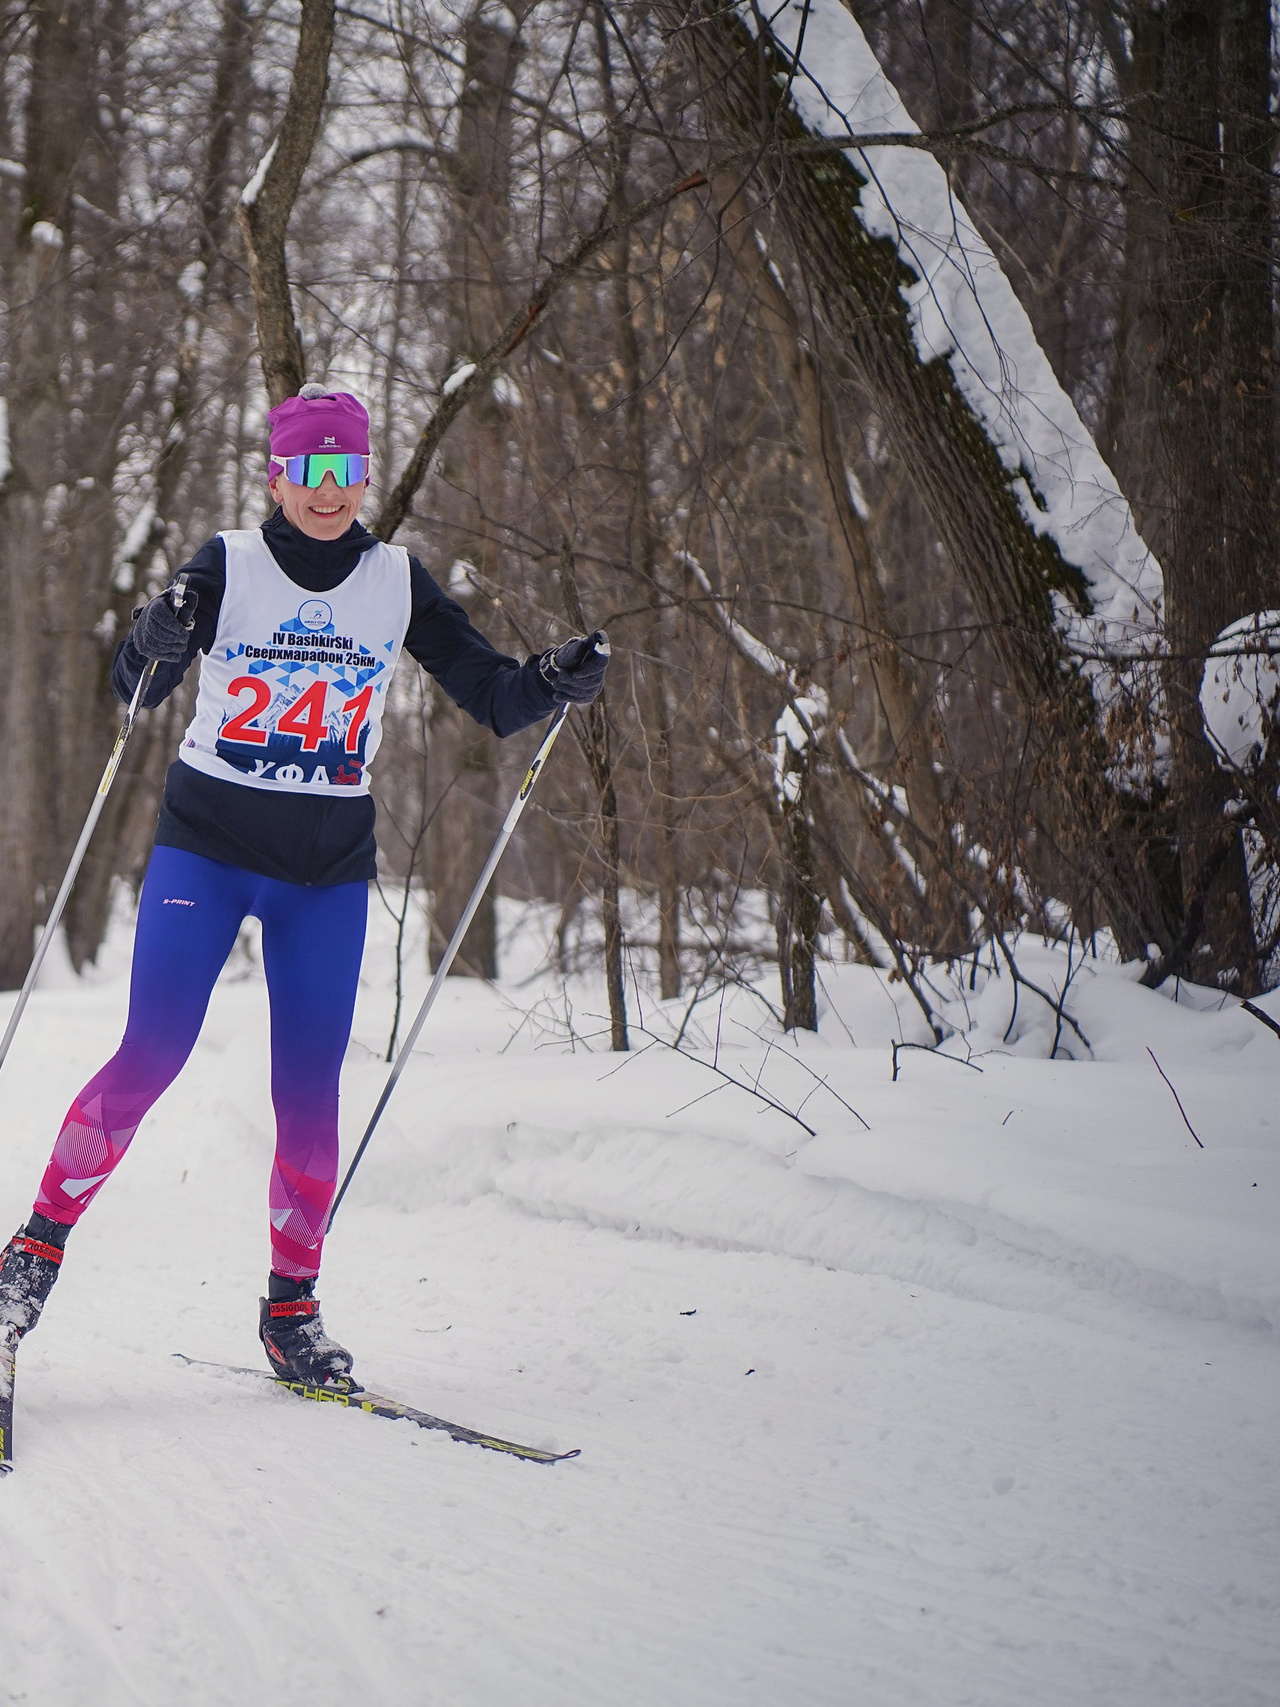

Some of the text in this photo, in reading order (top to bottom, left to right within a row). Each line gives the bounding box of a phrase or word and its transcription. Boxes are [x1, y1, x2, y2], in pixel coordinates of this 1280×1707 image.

[272, 632, 353, 650] IV BashkirSki
[245, 645, 343, 664] Сверхмарафон
[220, 675, 374, 754] 241
[247, 758, 331, 785] УФА
[163, 898, 196, 907] S-PRINT
[28, 1242, 64, 1261] ROSSIGNO
[270, 1303, 309, 1313] OSSIGNOL
